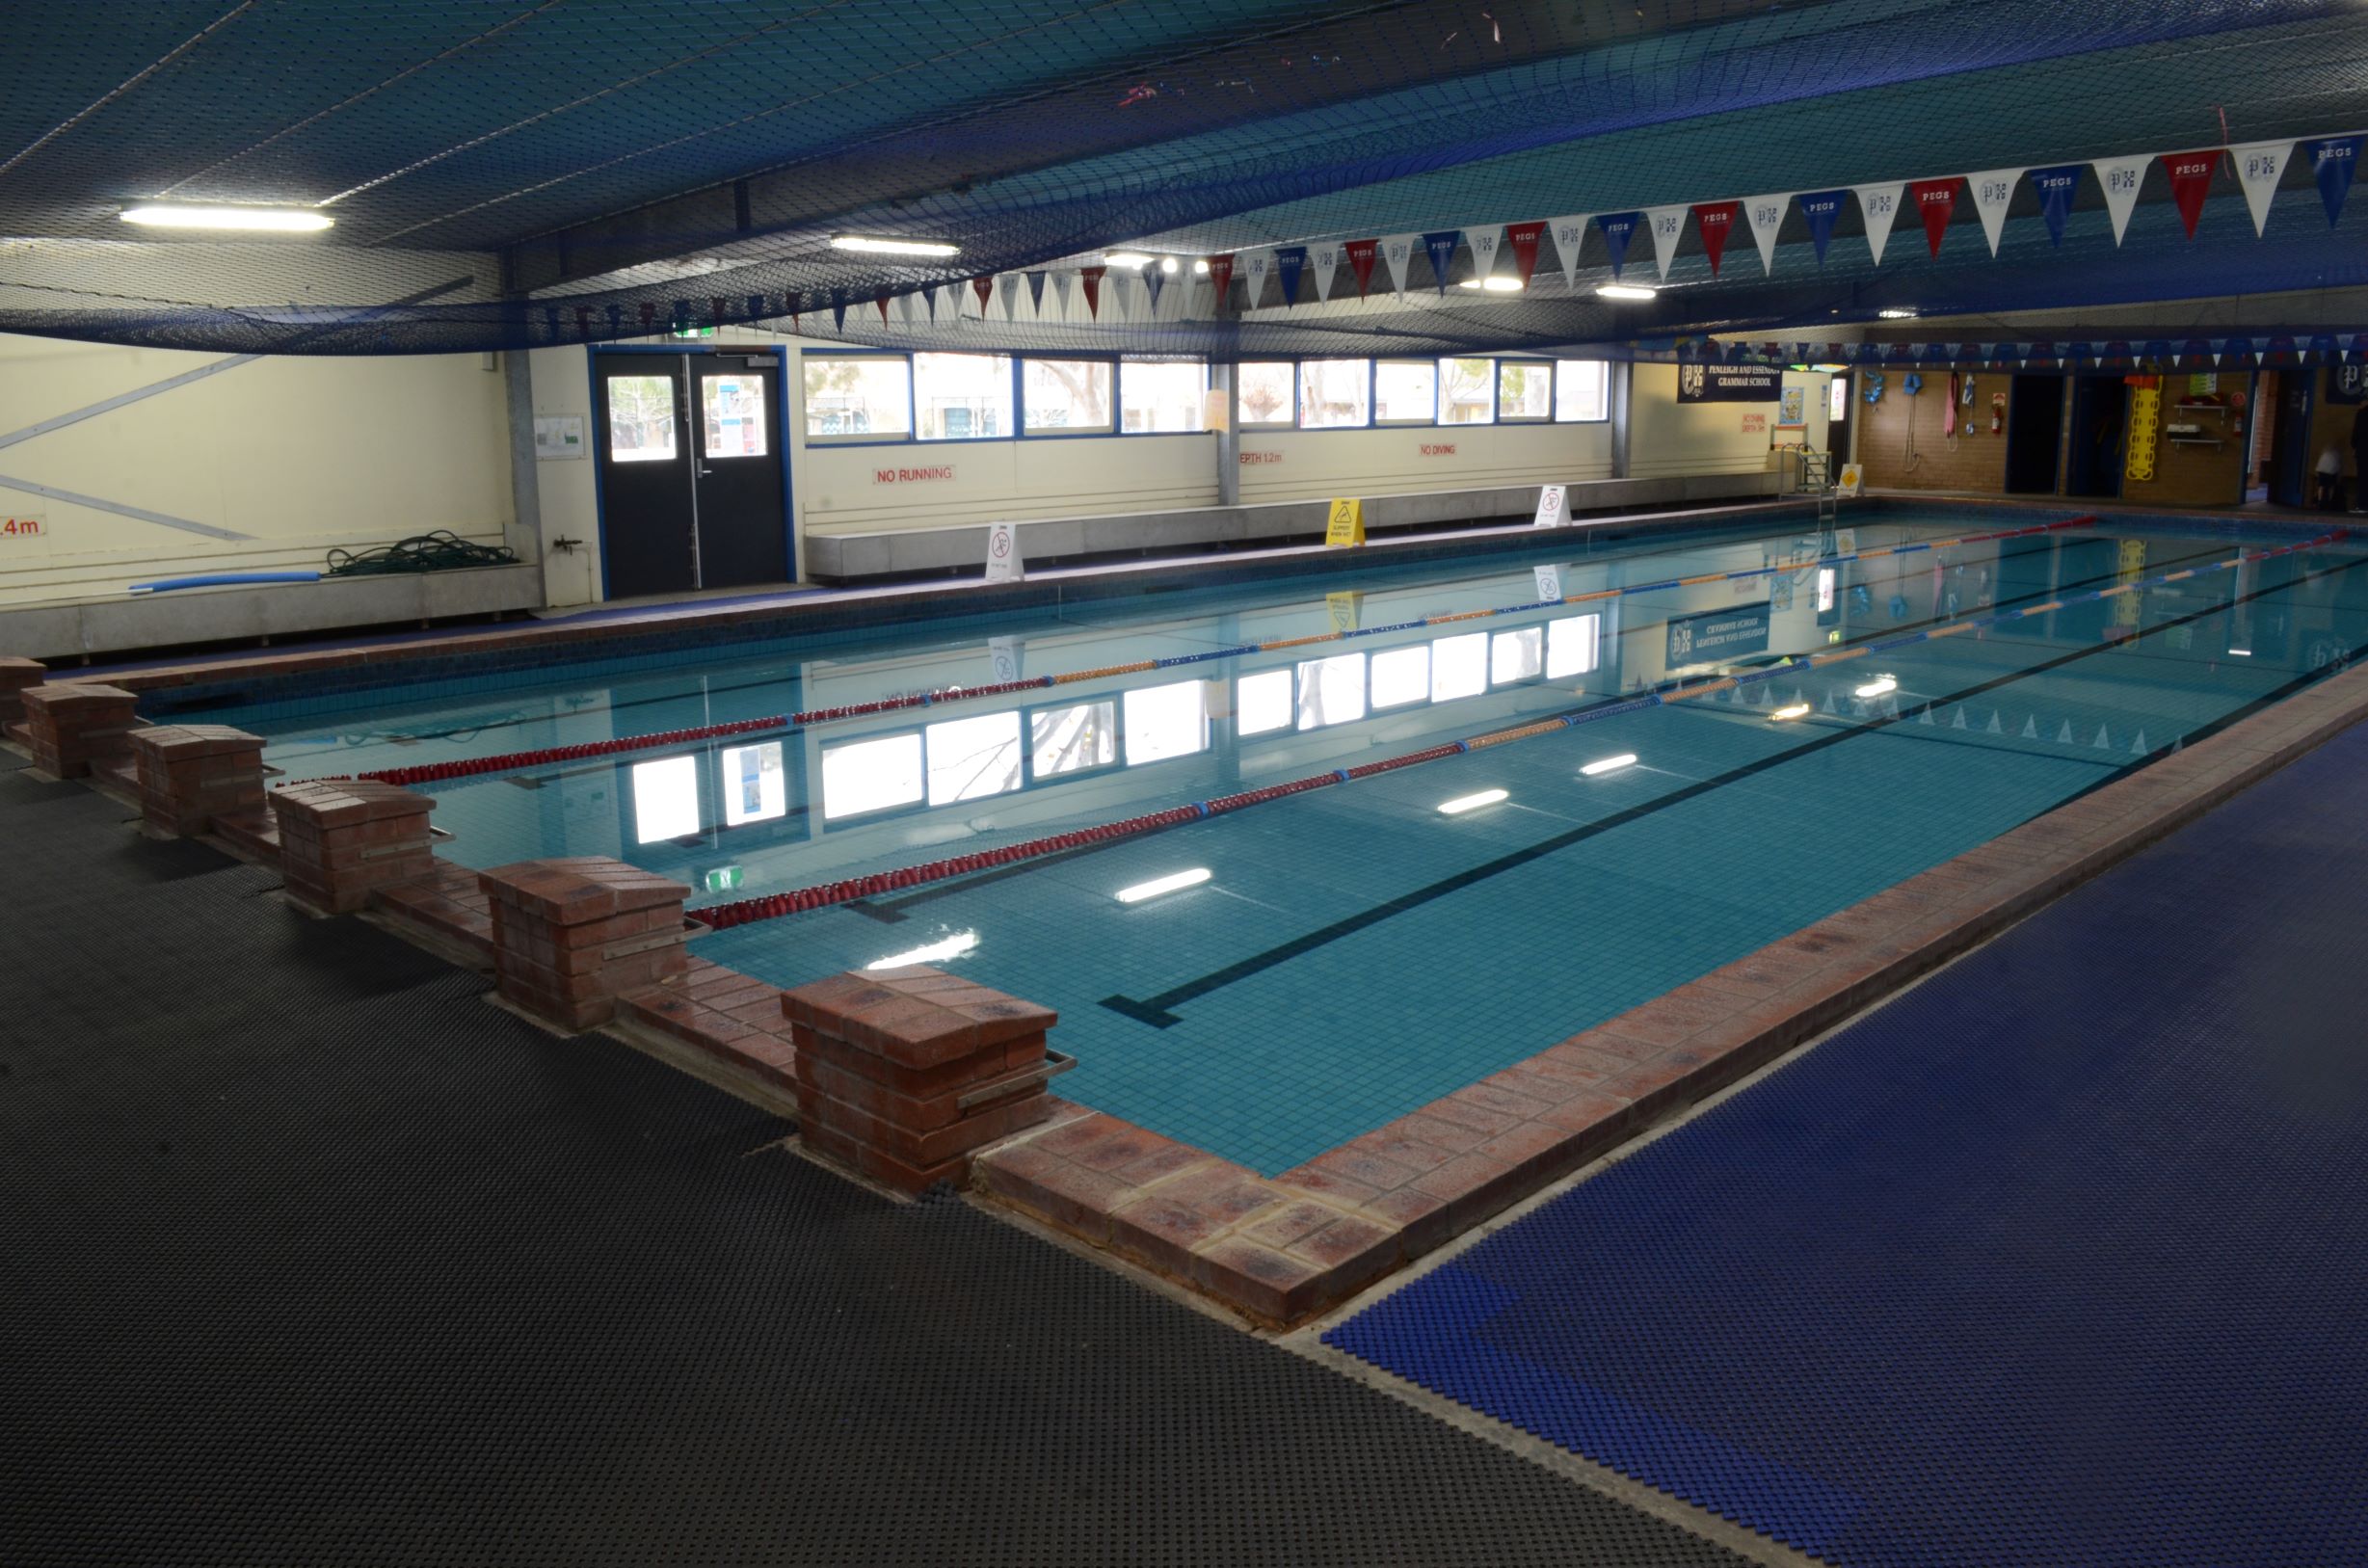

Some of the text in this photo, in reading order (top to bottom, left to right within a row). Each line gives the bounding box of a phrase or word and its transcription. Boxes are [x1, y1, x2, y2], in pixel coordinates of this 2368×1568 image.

[2318, 147, 2352, 159] PEGS
[2175, 164, 2207, 174] PEGS
[2042, 176, 2071, 188] PEGS
[1922, 191, 1950, 201] PEGS
[1809, 201, 1835, 212] PEGS
[1704, 213, 1728, 223] PEGS
[1608, 223, 1629, 232] PEGS
[1515, 232, 1535, 242] PEGS
[1709, 365, 1739, 375] PENLEIGH
[1739, 365, 1751, 375] AND
[1717, 377, 1771, 386] GRAMMAR SCHOOL
[1421, 444, 1455, 455] NO DIVING
[1239, 453, 1262, 464] EPTH
[877, 466, 952, 483] NO RUNNING
[0, 518, 39, 535] .4m
